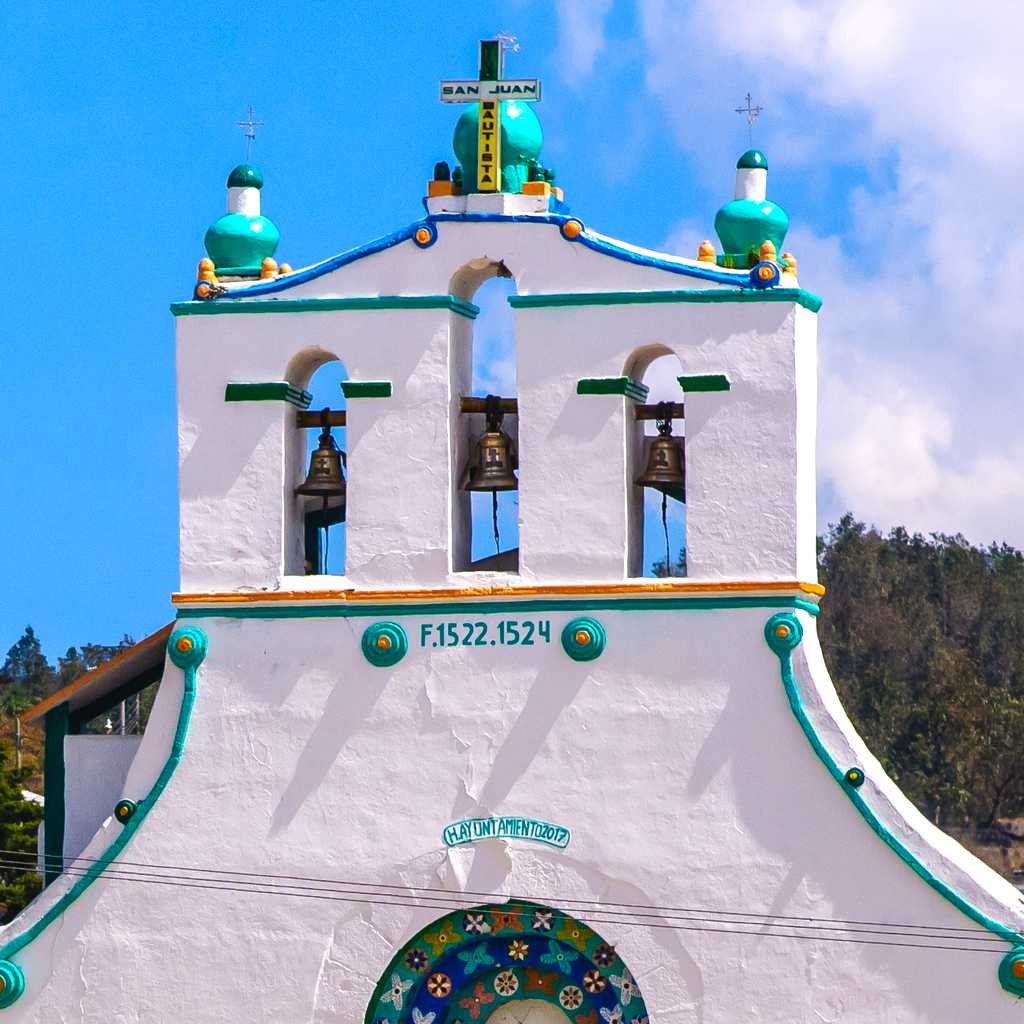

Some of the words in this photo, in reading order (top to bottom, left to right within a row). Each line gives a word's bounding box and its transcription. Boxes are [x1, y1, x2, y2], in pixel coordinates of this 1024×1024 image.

[442, 85, 480, 95] SAN
[489, 84, 537, 94] JUAN
[481, 101, 495, 183] BAUTISTA
